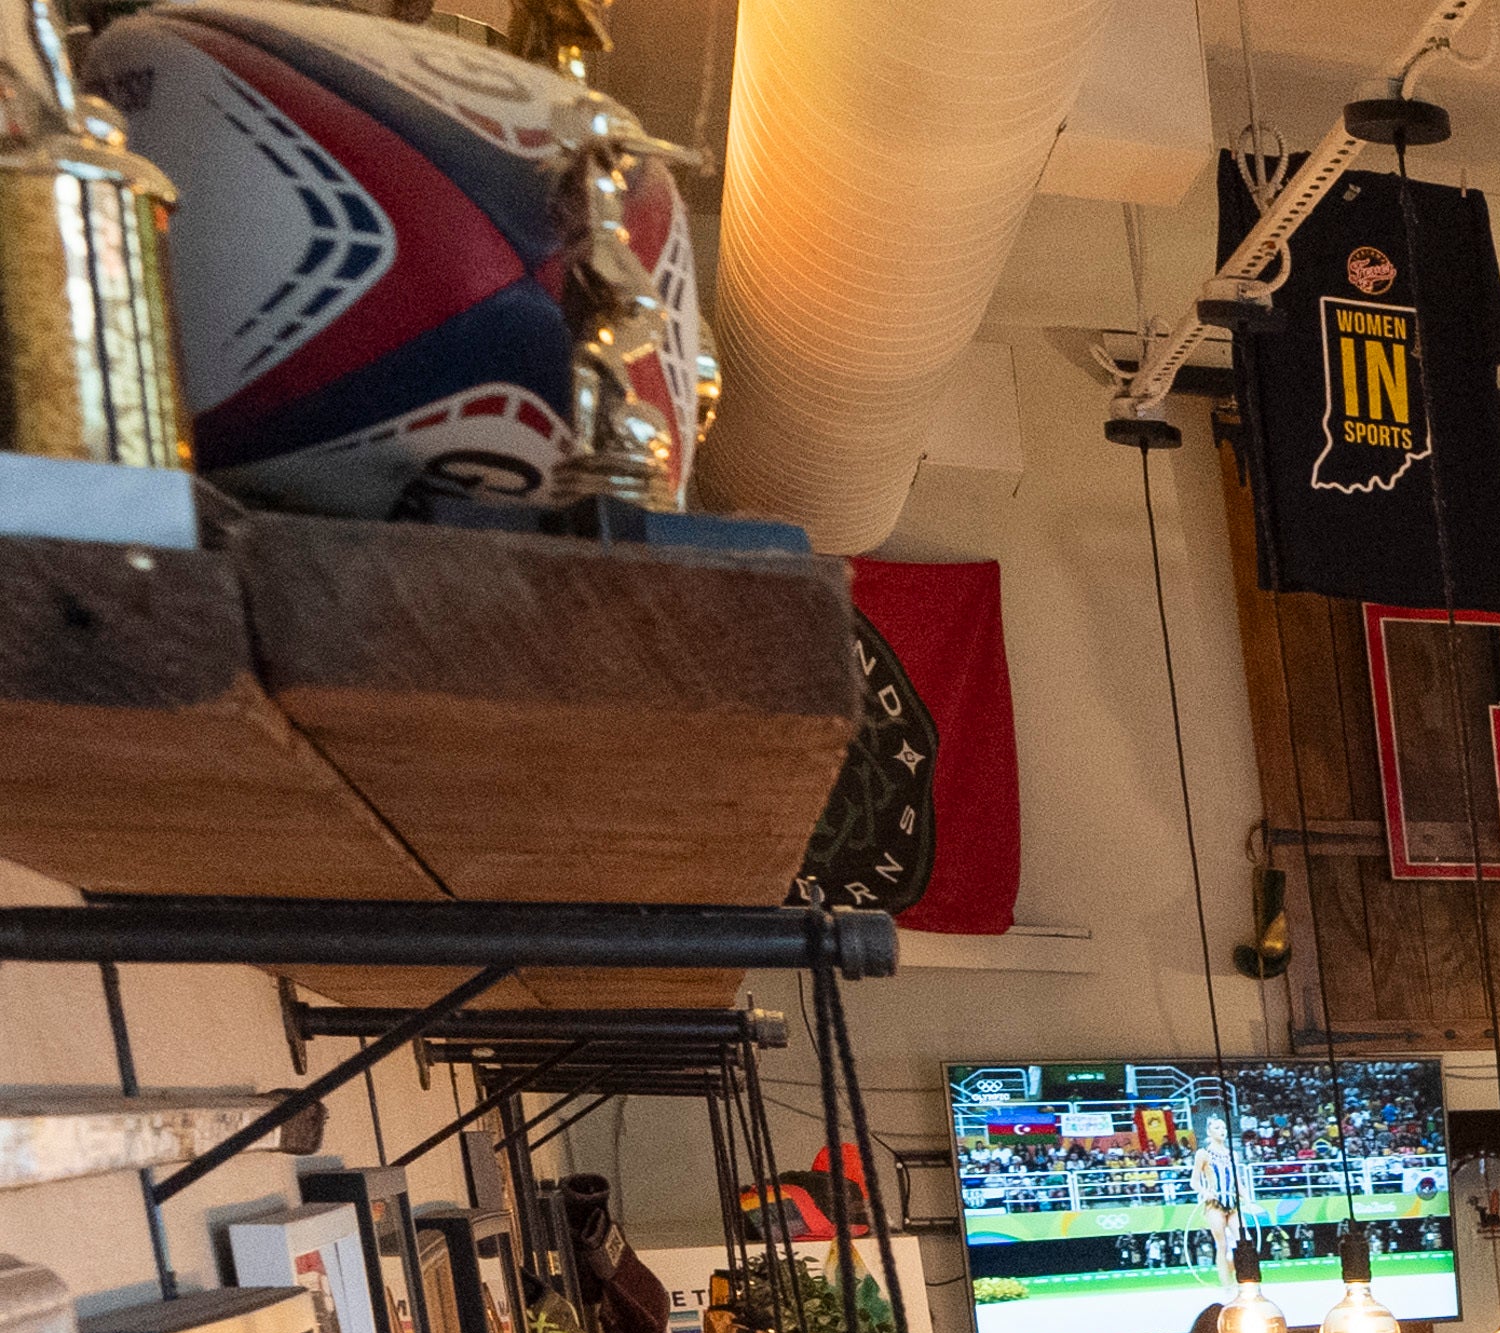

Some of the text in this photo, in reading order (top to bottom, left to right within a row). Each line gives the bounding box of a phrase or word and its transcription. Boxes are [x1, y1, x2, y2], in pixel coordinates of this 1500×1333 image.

[1336, 309, 1408, 340] WOMEN
[1340, 337, 1409, 424] IN
[1344, 421, 1412, 450] SPORTS
